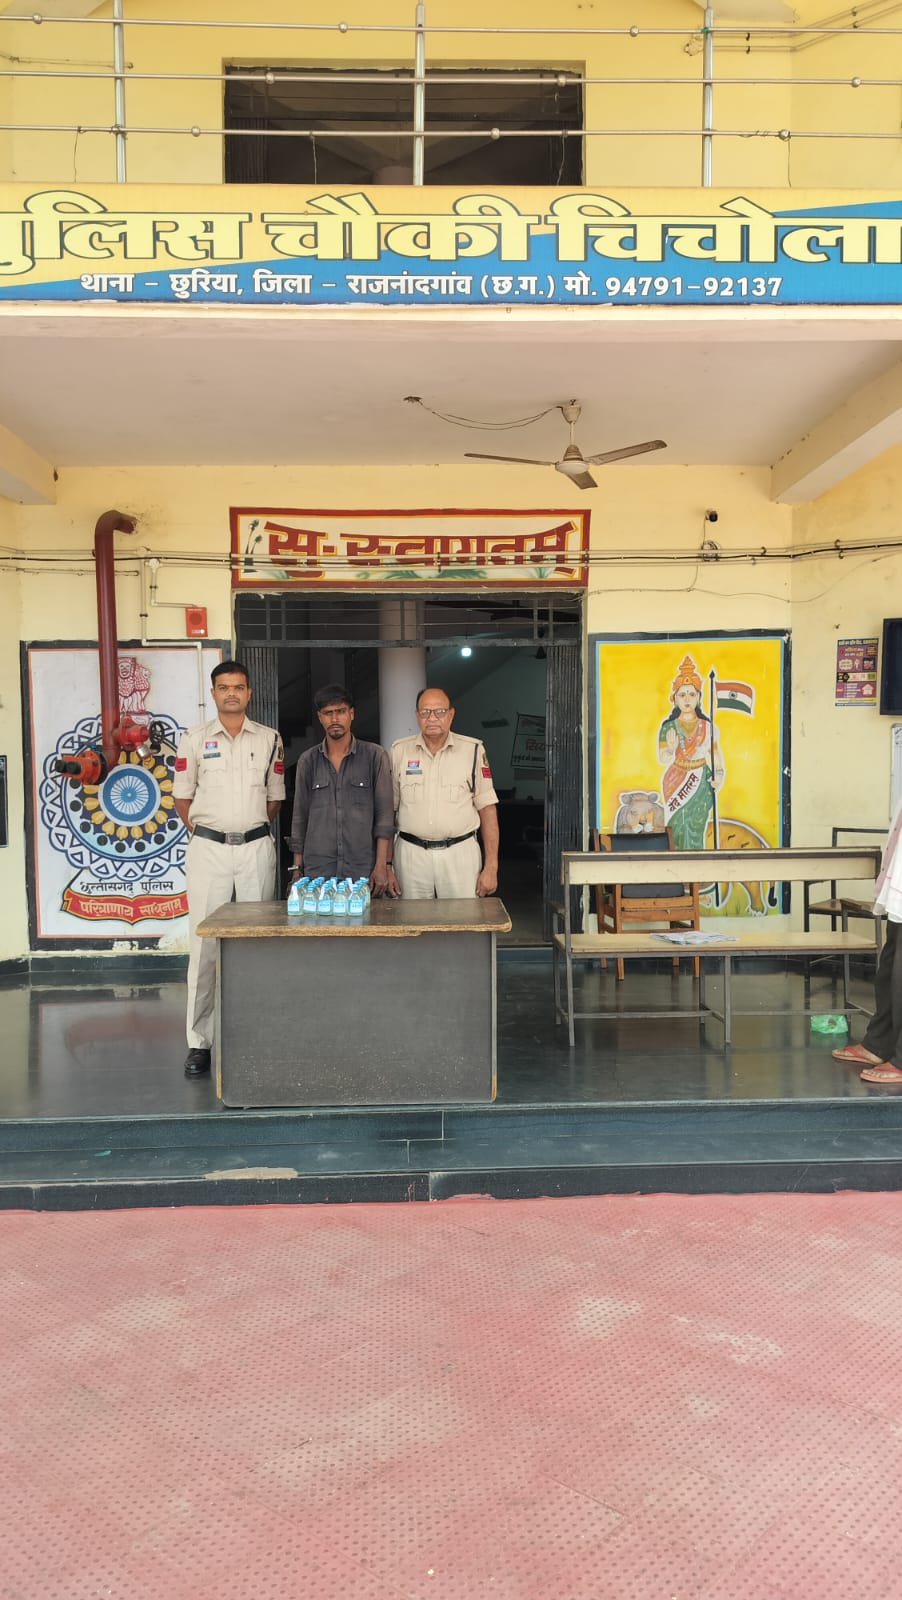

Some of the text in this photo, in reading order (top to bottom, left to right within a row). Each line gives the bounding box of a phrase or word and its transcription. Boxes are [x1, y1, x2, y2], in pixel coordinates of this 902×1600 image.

[262, 192, 542, 262] चौकी
[545, 193, 902, 264] चिचोला
[80, 273, 135, 294] थाना
[169, 268, 243, 299] छुरिया,
[253, 268, 313, 294] जिला
[345, 271, 473, 295] राजनांदगांव
[480, 275, 555, 298] (छ.ग.)
[563, 270, 597, 296] मो.
[605, 276, 783, 297] 94791-92137
[140, 878, 174, 894] पुलिस
